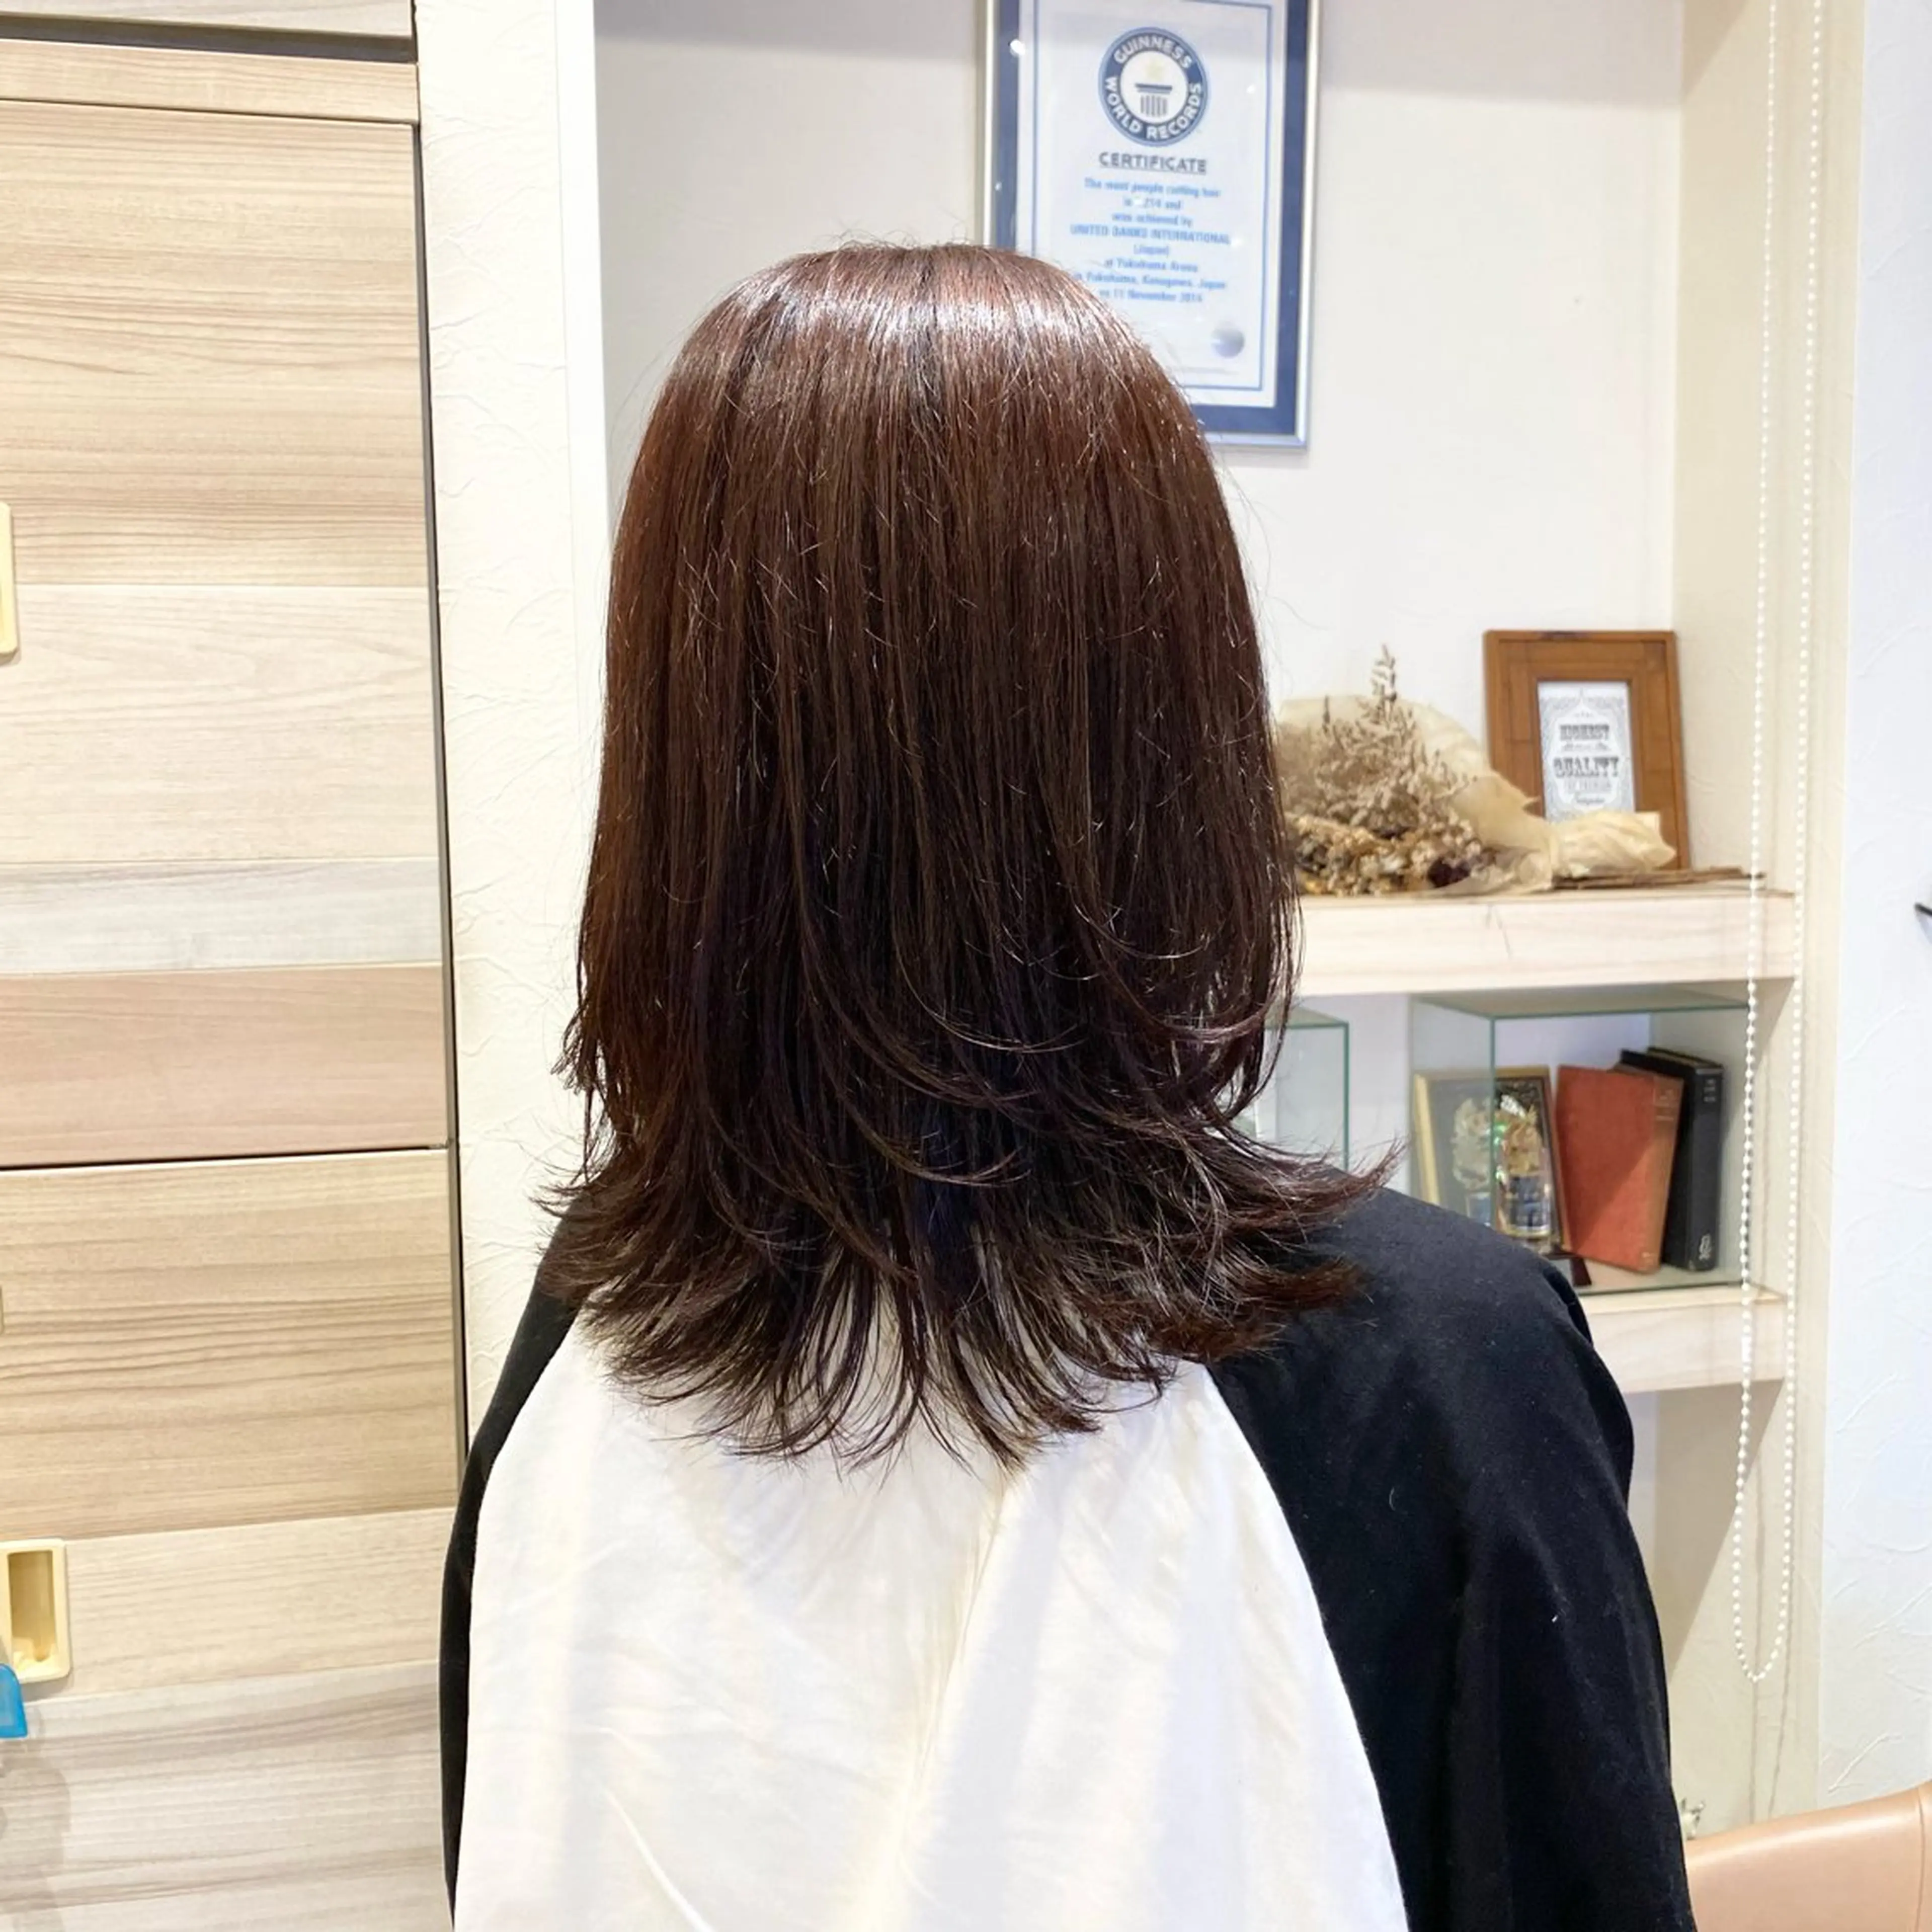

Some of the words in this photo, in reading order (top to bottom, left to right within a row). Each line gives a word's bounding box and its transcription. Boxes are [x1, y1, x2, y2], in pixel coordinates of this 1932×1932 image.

[1113, 35, 1193, 68] GUINNESS
[1105, 76, 1143, 133] WORLD
[1146, 82, 1202, 139] RECORDS
[1098, 151, 1207, 173] CERTIFICATE
[1150, 228, 1231, 244] INTERNATIONAL
[1553, 756, 1619, 779] QUALITY
